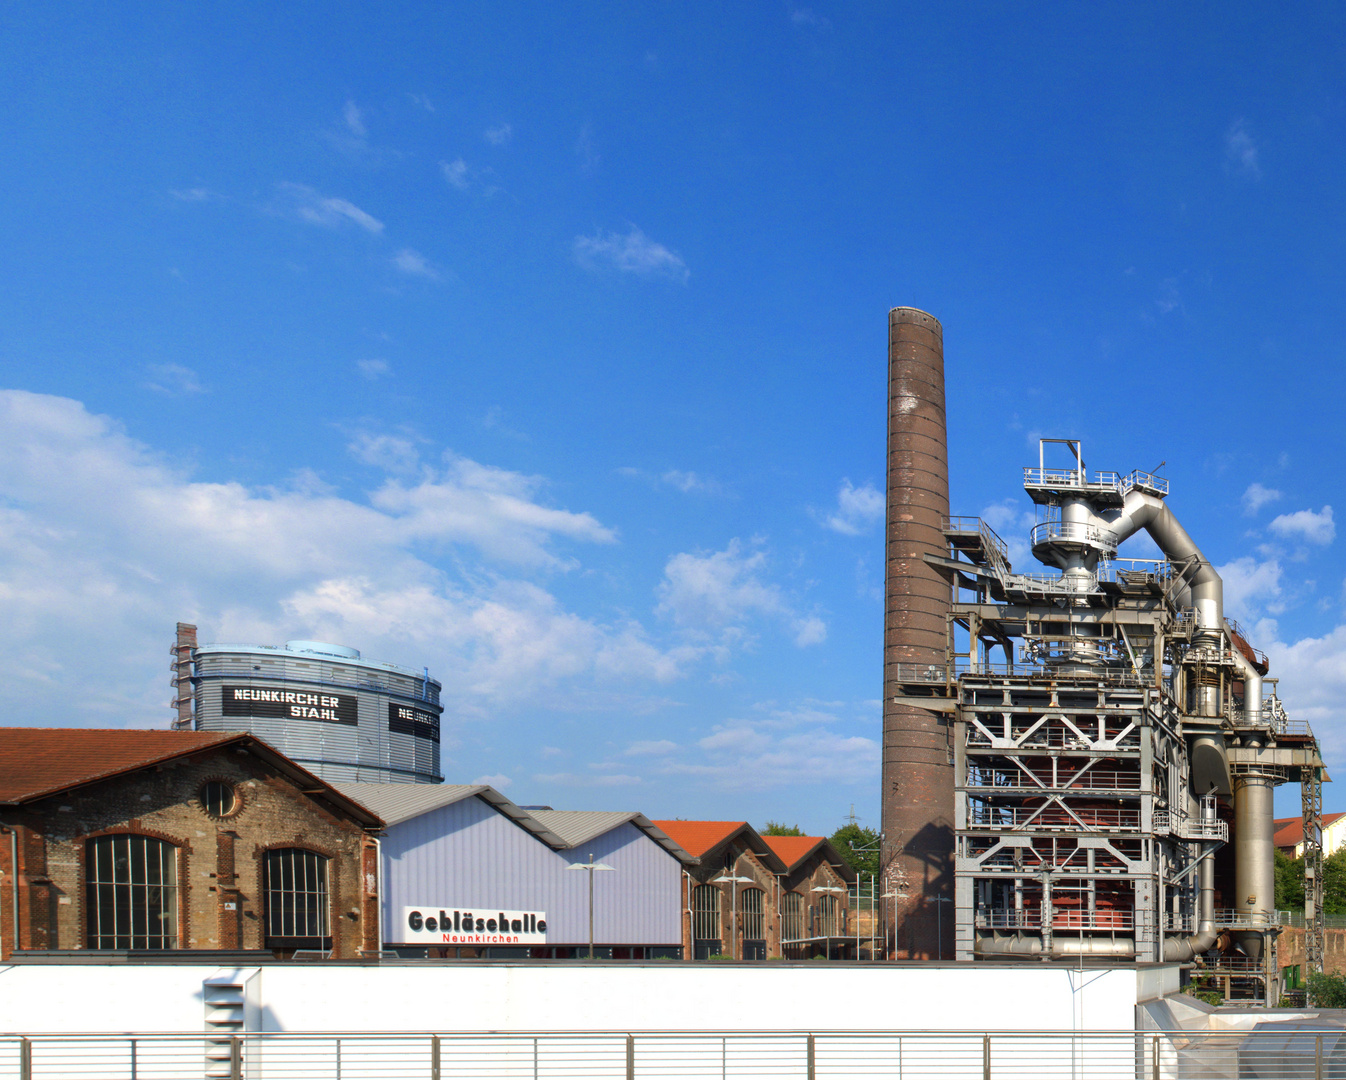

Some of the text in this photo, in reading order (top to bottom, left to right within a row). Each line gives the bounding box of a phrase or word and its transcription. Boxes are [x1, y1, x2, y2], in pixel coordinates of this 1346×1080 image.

[234, 689, 339, 708] NEUNKIRCHER
[290, 705, 340, 721] STAHL
[408, 910, 547, 933] Gebläsehalle
[442, 934, 519, 943] Neunkirchen
